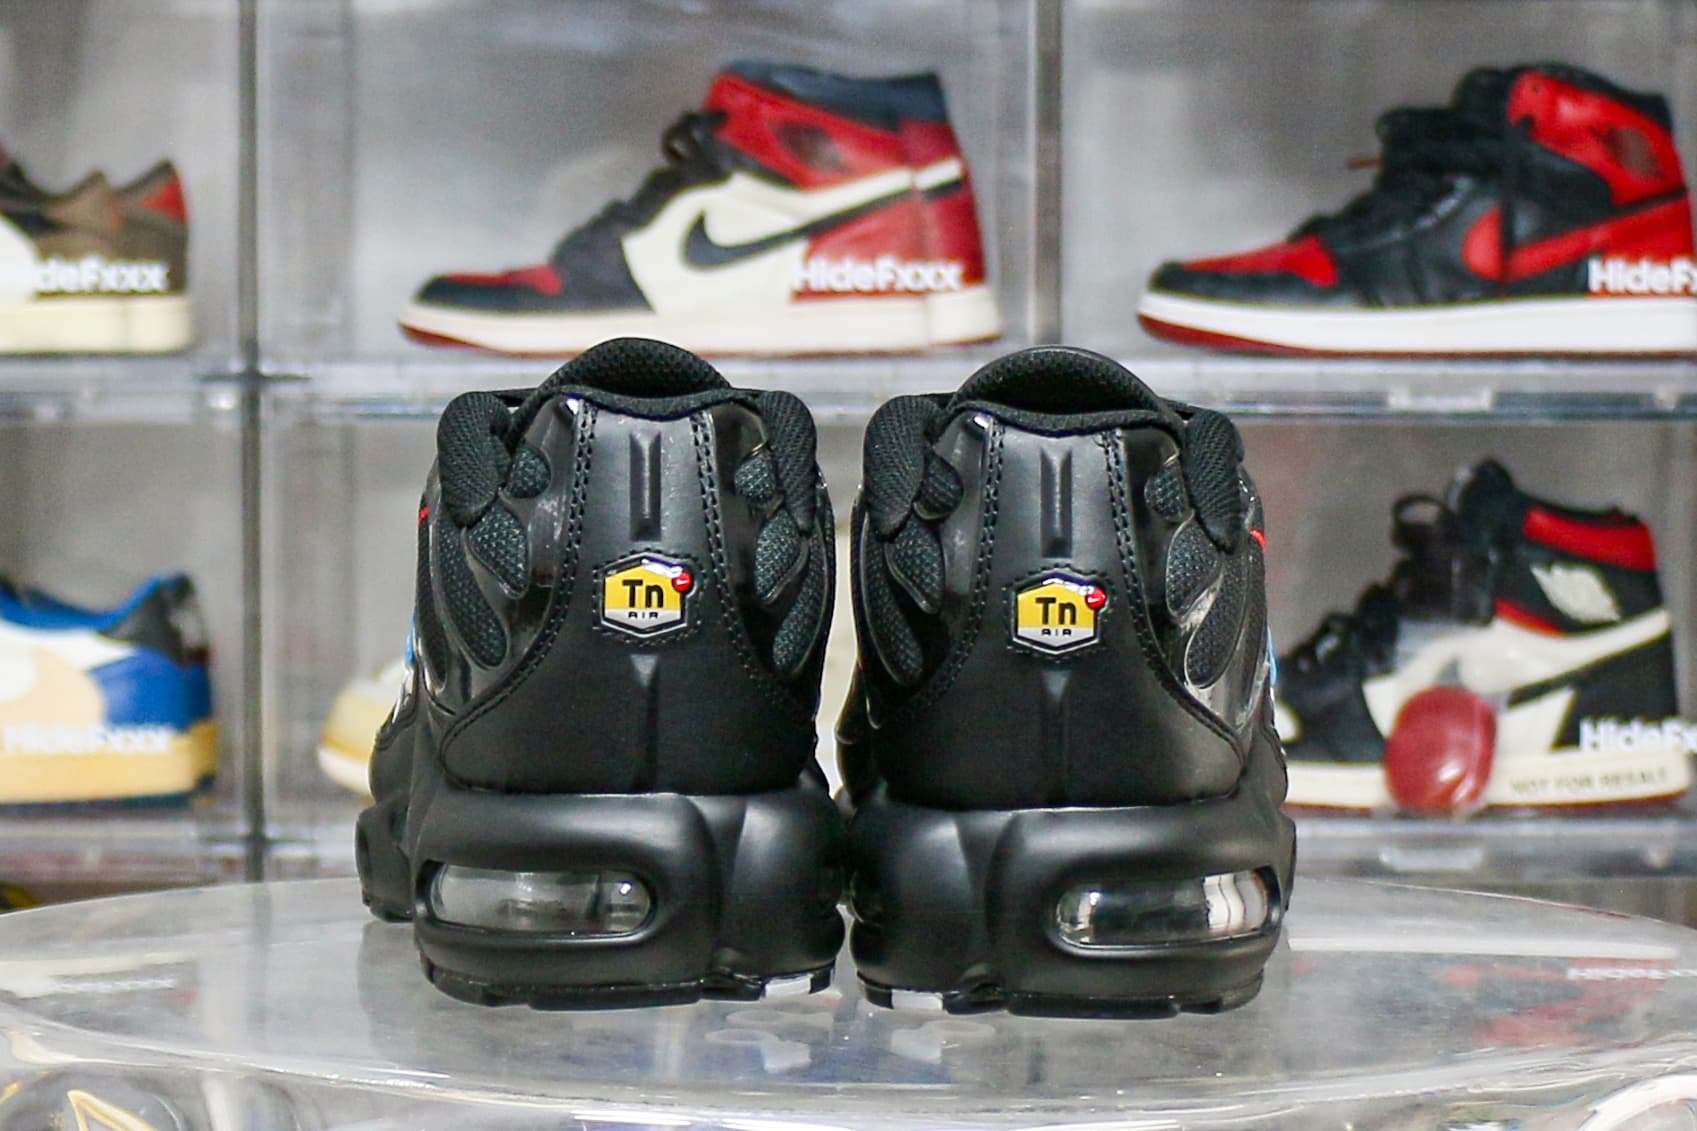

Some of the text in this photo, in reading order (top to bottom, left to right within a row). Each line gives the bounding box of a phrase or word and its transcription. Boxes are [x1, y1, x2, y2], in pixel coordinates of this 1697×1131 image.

[622, 579, 664, 608] Tn
[628, 611, 659, 619] AIR
[1035, 597, 1077, 625] Tn
[1041, 628, 1072, 637] AIR
